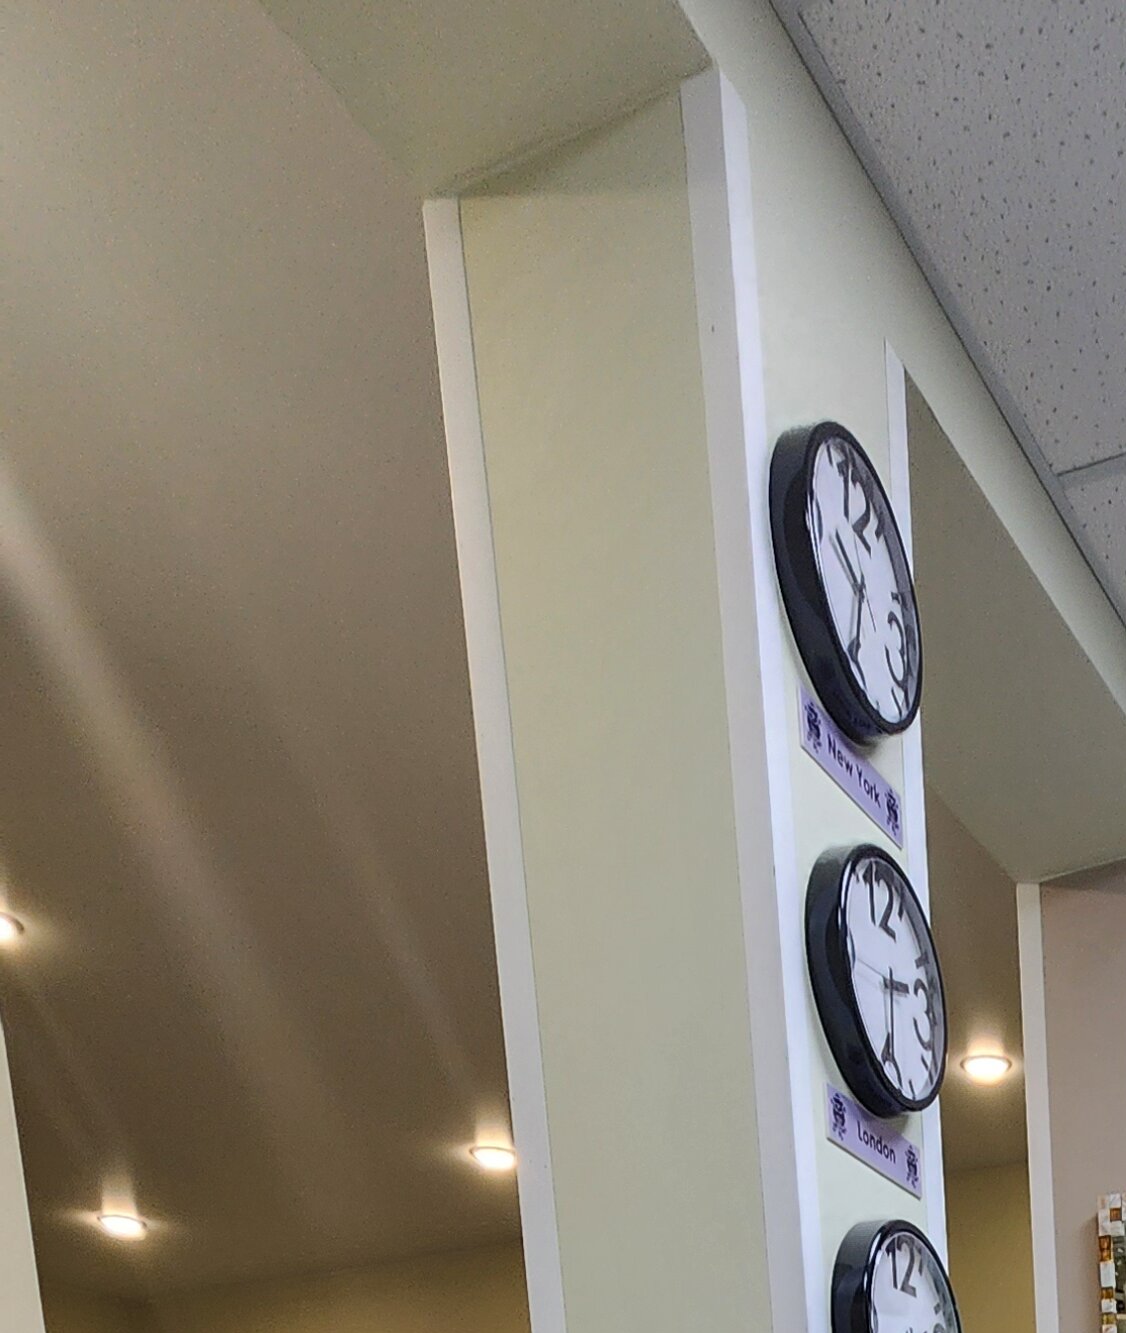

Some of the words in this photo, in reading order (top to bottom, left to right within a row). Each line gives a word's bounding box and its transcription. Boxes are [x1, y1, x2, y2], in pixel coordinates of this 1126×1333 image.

[837, 459, 872, 559] 12
[885, 611, 907, 690] 3
[827, 733, 853, 777] New
[856, 763, 882, 809] York
[863, 861, 897, 942] 12
[914, 978, 934, 1051] 3
[856, 1119, 897, 1165] London
[885, 1240, 917, 1298] 12
